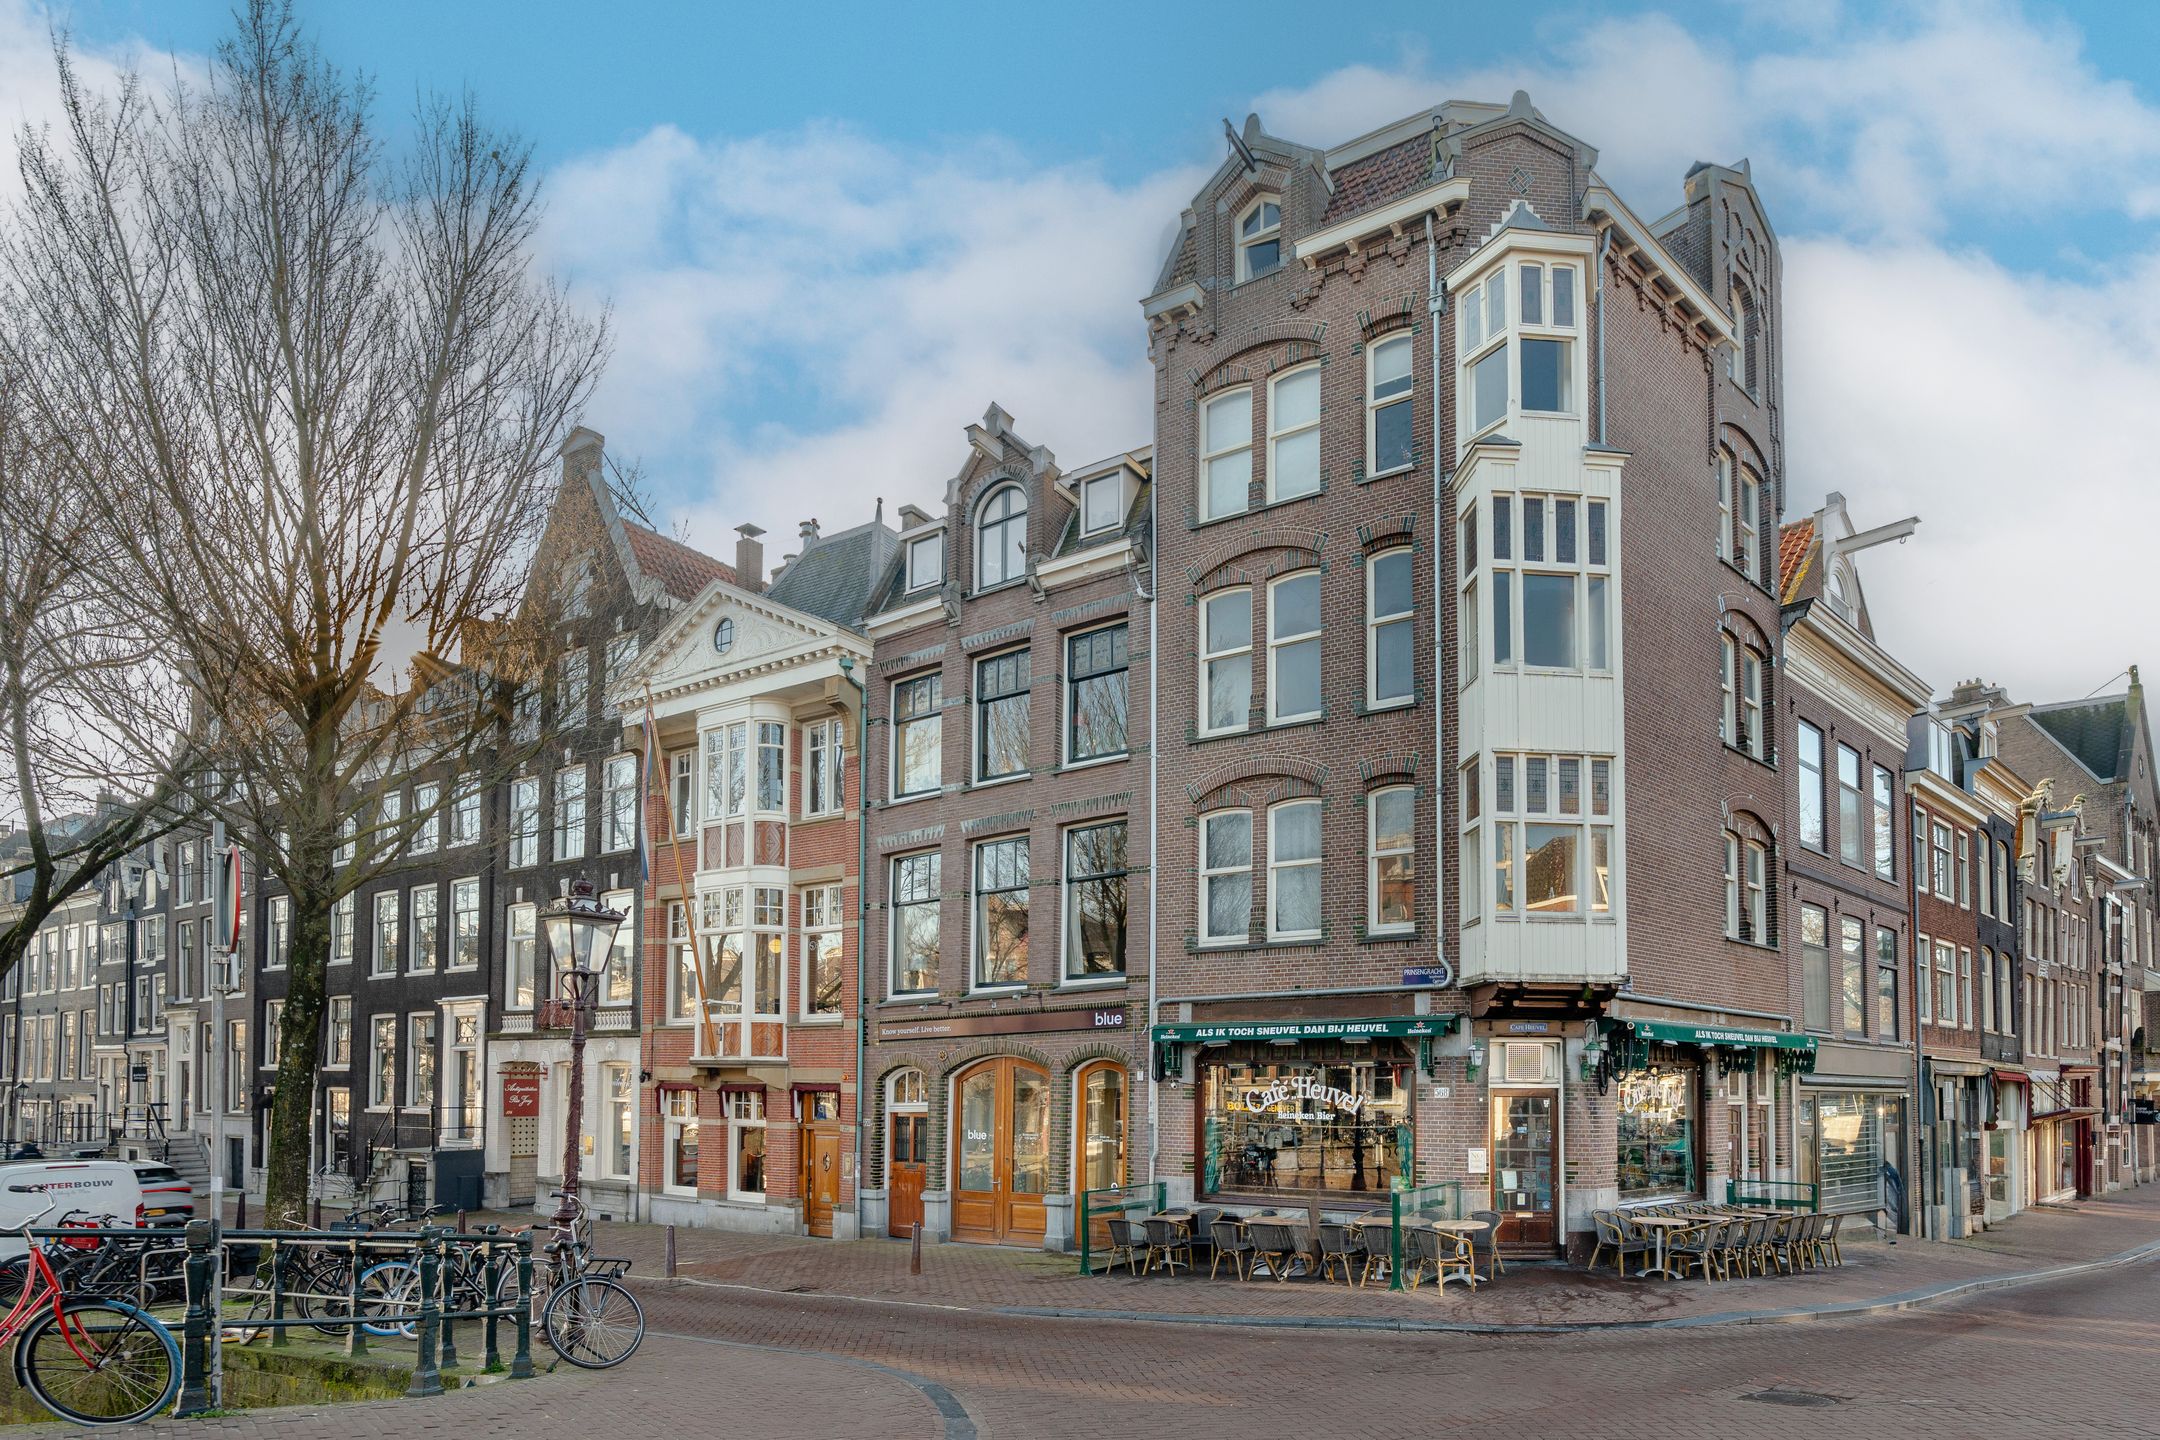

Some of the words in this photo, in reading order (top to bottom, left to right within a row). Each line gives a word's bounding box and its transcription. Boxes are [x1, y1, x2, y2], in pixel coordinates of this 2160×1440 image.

[1095, 1012, 1122, 1026] blue
[898, 1026, 920, 1036] yourself.
[1228, 1028, 1254, 1036] TOCH
[1257, 1026, 1302, 1035] SNEUVEL
[1304, 1025, 1325, 1034] DAN
[1328, 1024, 1344, 1033] BIJ
[1346, 1024, 1389, 1032] HEUVEL
[1696, 1030, 1705, 1038] ALS
[1711, 1032, 1724, 1040] TOCH
[1246, 1080, 1290, 1113] Café
[1435, 1088, 1448, 1097] 568
[1278, 1111, 1314, 1120] Heineken
[1316, 1111, 1336, 1120] Bier
[967, 1129, 987, 1140] blue
